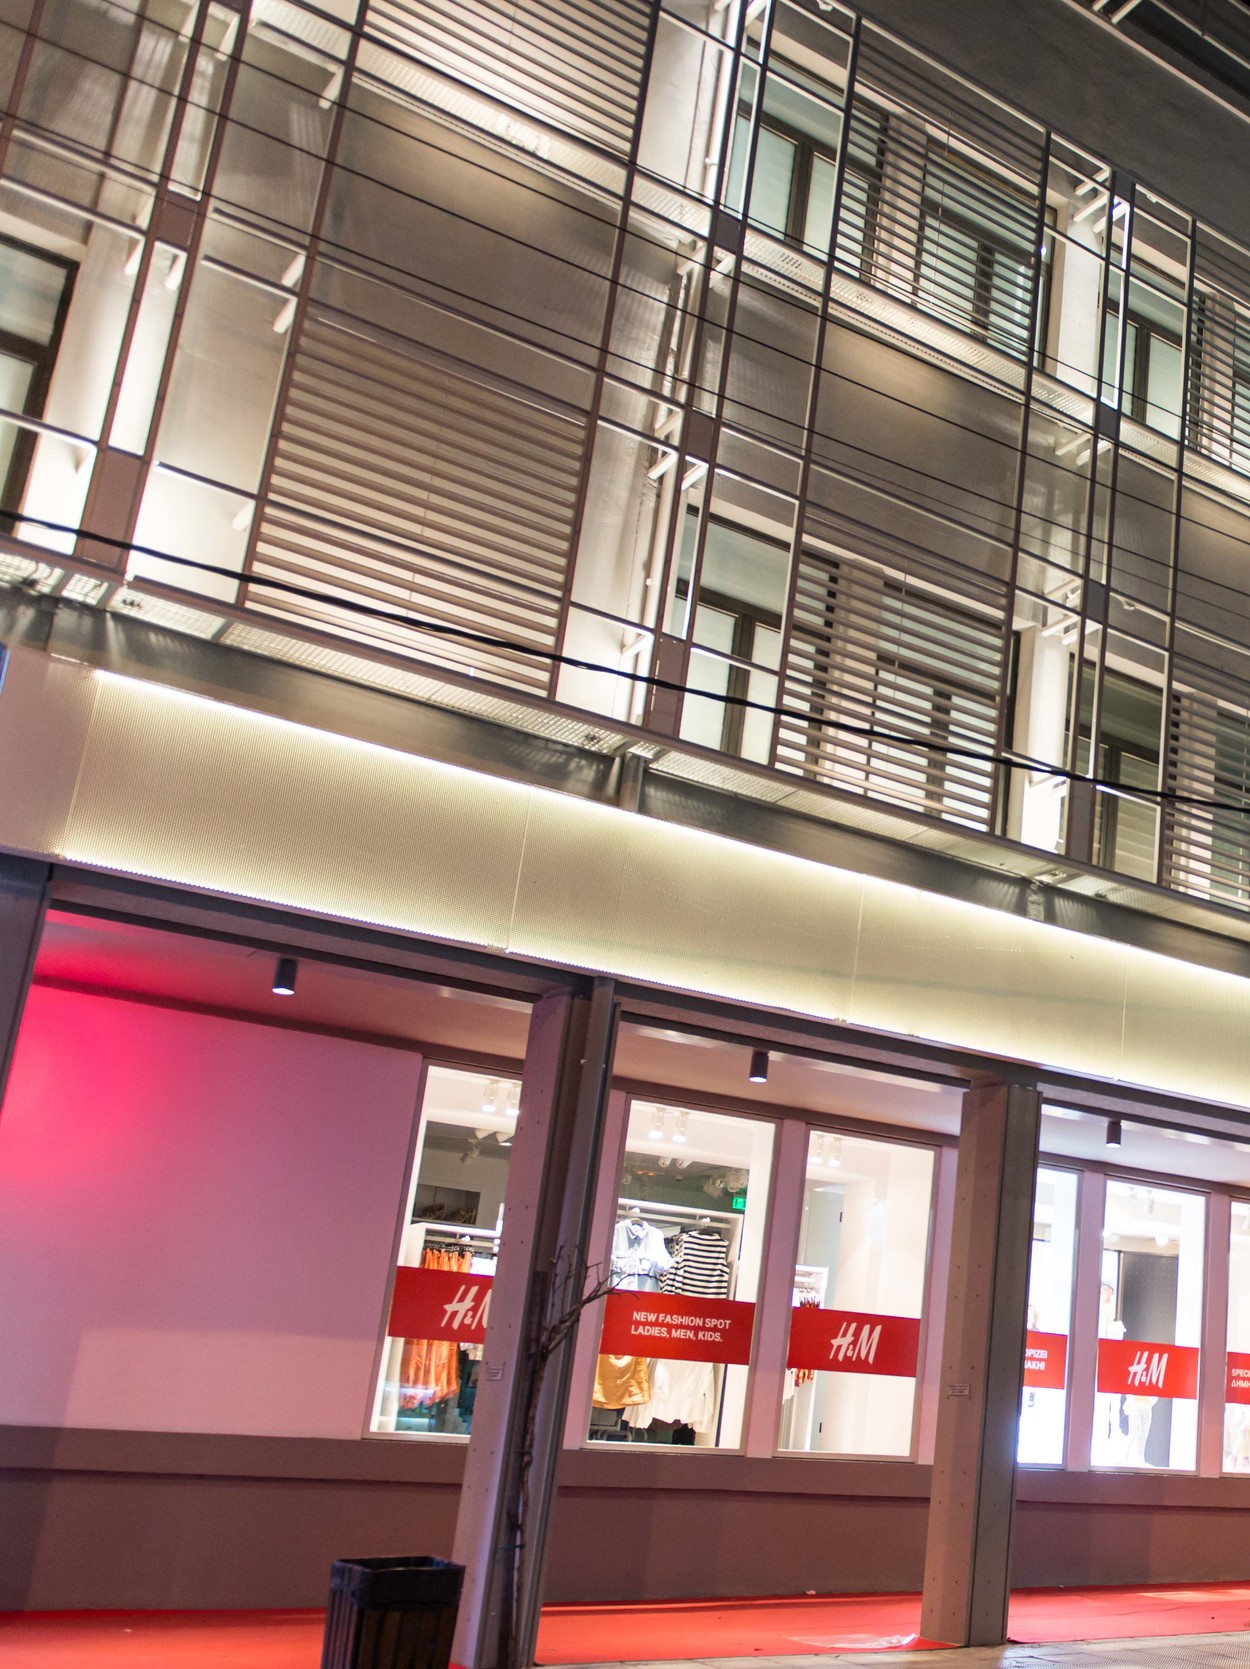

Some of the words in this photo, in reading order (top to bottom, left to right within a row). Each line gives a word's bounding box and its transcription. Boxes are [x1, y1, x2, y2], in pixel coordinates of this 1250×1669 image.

[631, 1325, 669, 1338] LADIES,
[671, 1328, 696, 1340] MEN,
[698, 1331, 723, 1342] KIDS.
[632, 1311, 657, 1322] NEW
[659, 1313, 703, 1327] FASHION
[705, 1318, 731, 1329] SPOT
[829, 1321, 882, 1365] H&M
[1127, 1350, 1169, 1389] H&M
